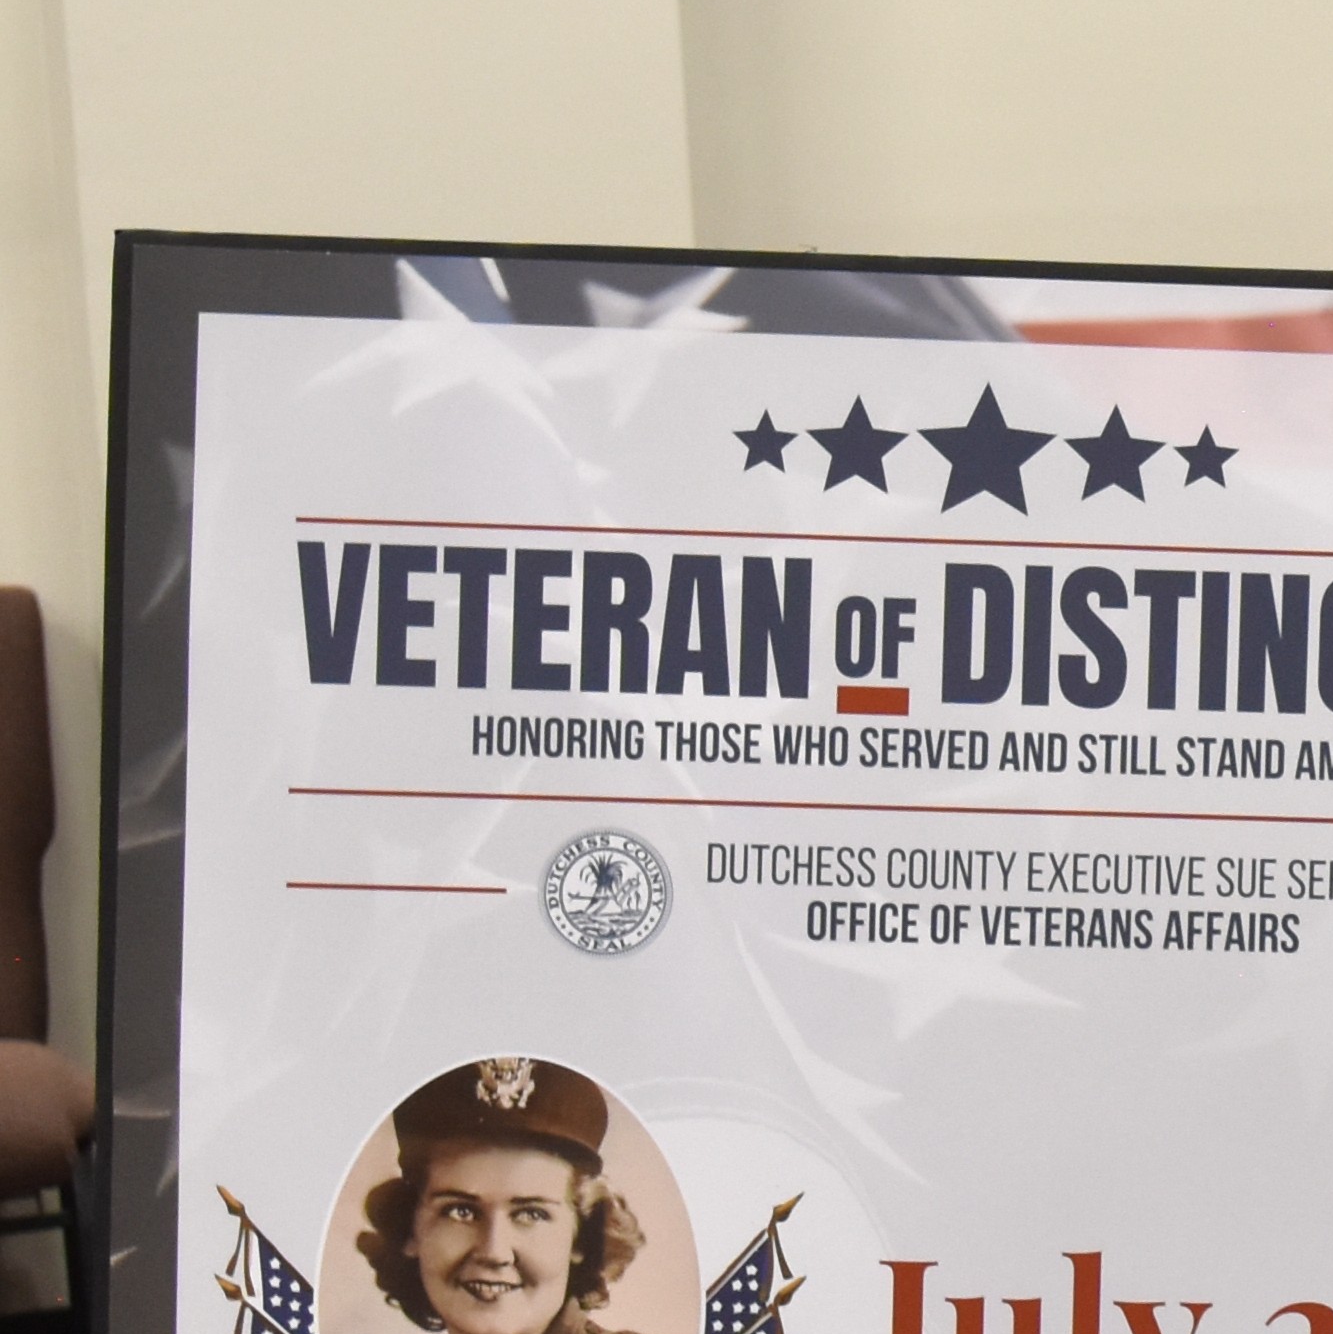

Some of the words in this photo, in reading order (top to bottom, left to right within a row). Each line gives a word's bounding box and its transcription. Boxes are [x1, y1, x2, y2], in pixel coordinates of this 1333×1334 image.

[296, 540, 813, 700] VETERAN
[834, 593, 918, 681] OF
[472, 714, 645, 761] HONORING
[654, 720, 763, 765] THOSE
[772, 723, 849, 767] WHO
[858, 726, 989, 771] SERVED
[998, 730, 1068, 773] AND
[1077, 733, 1167, 776] STILL
[1175, 735, 1286, 780] STAND
[623, 840, 663, 911] COUNTY
[706, 842, 877, 888] DUTCHESS
[886, 847, 1017, 892] COUNTY
[1027, 851, 1207, 897] EXECUTIVE
[1215, 856, 1278, 899] SUE
[806, 899, 921, 944] OFFICE
[930, 903, 972, 945] OF
[980, 904, 1154, 950] VETERANS
[1162, 909, 1301, 954] AFFAIRS
